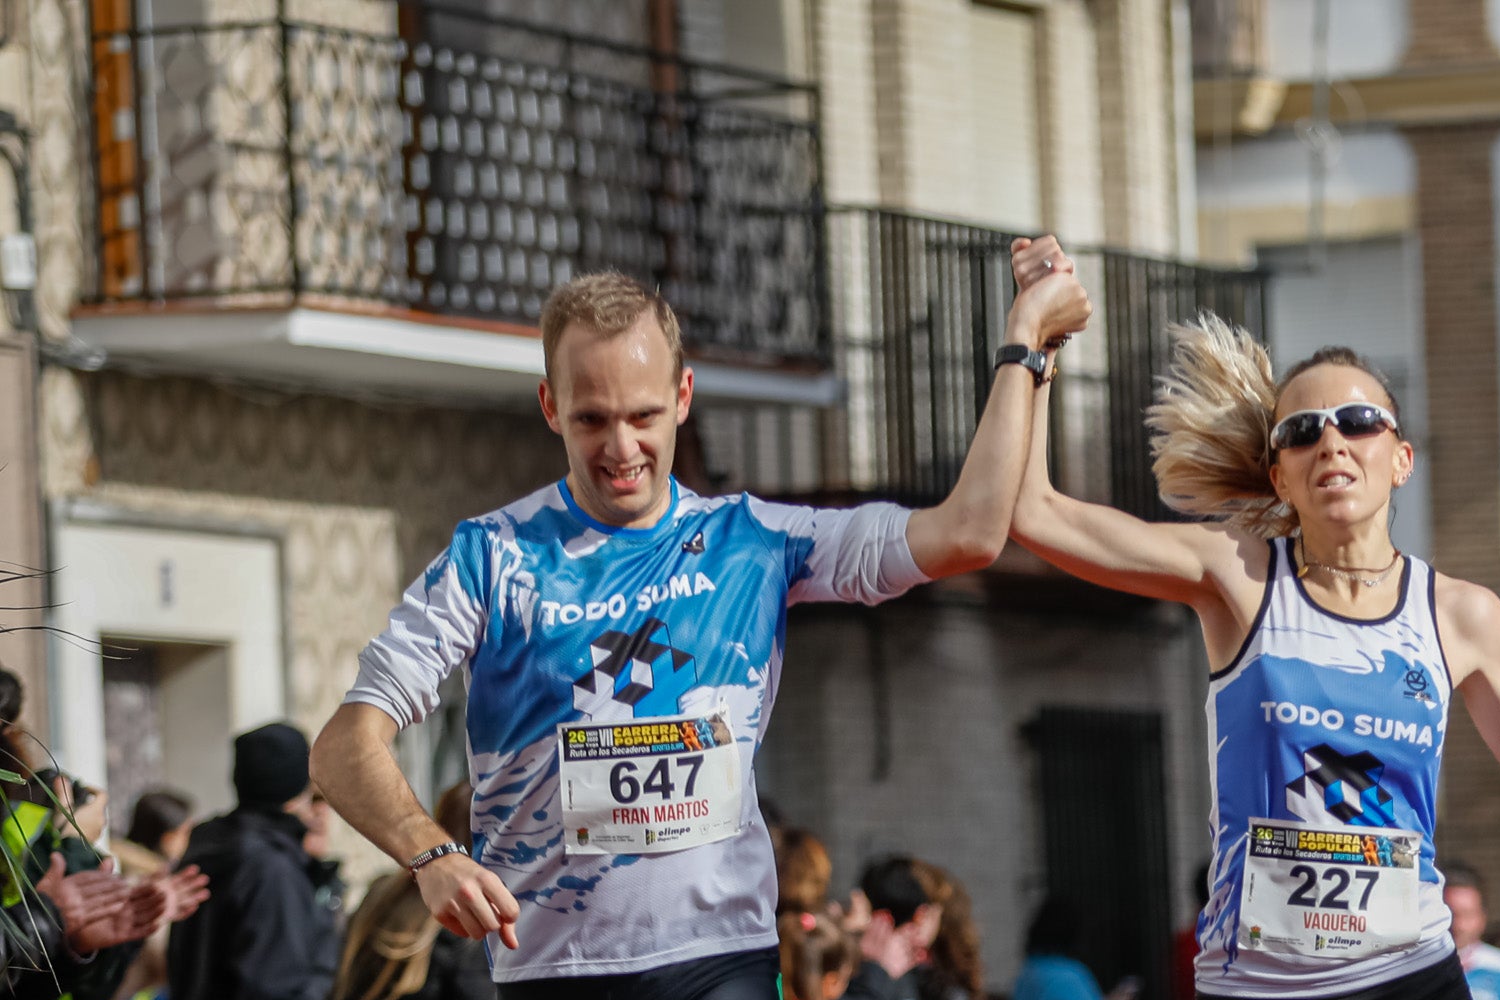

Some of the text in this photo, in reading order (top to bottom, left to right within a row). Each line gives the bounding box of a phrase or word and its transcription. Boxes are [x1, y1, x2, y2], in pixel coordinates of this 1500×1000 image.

[541, 571, 715, 625] TODO SUMA
[613, 724, 680, 737] CARRERA
[1260, 701, 1433, 747] TODO SUMA
[568, 730, 586, 744] 26
[599, 728, 614, 747] VII
[614, 734, 679, 746] POPULAR
[569, 748, 587, 758] Ruta
[588, 748, 598, 756] de
[599, 747, 610, 756] los
[612, 745, 651, 755] Secaderos
[609, 754, 705, 804] 647
[612, 799, 709, 825] FRAN MARTOS
[658, 825, 691, 837] olimpo
[1256, 828, 1273, 840] 26
[1299, 831, 1360, 845] CARRERA
[1285, 830, 1298, 848] VII
[1255, 845, 1272, 854] Ruta
[1273, 846, 1282, 855] de
[1283, 848, 1293, 856] los
[1295, 850, 1332, 860] Secaderos
[1298, 841, 1360, 853] POPULAR
[1287, 865, 1380, 911] 227
[1303, 911, 1367, 933] VAQUERO
[1328, 935, 1362, 946] olimpo
